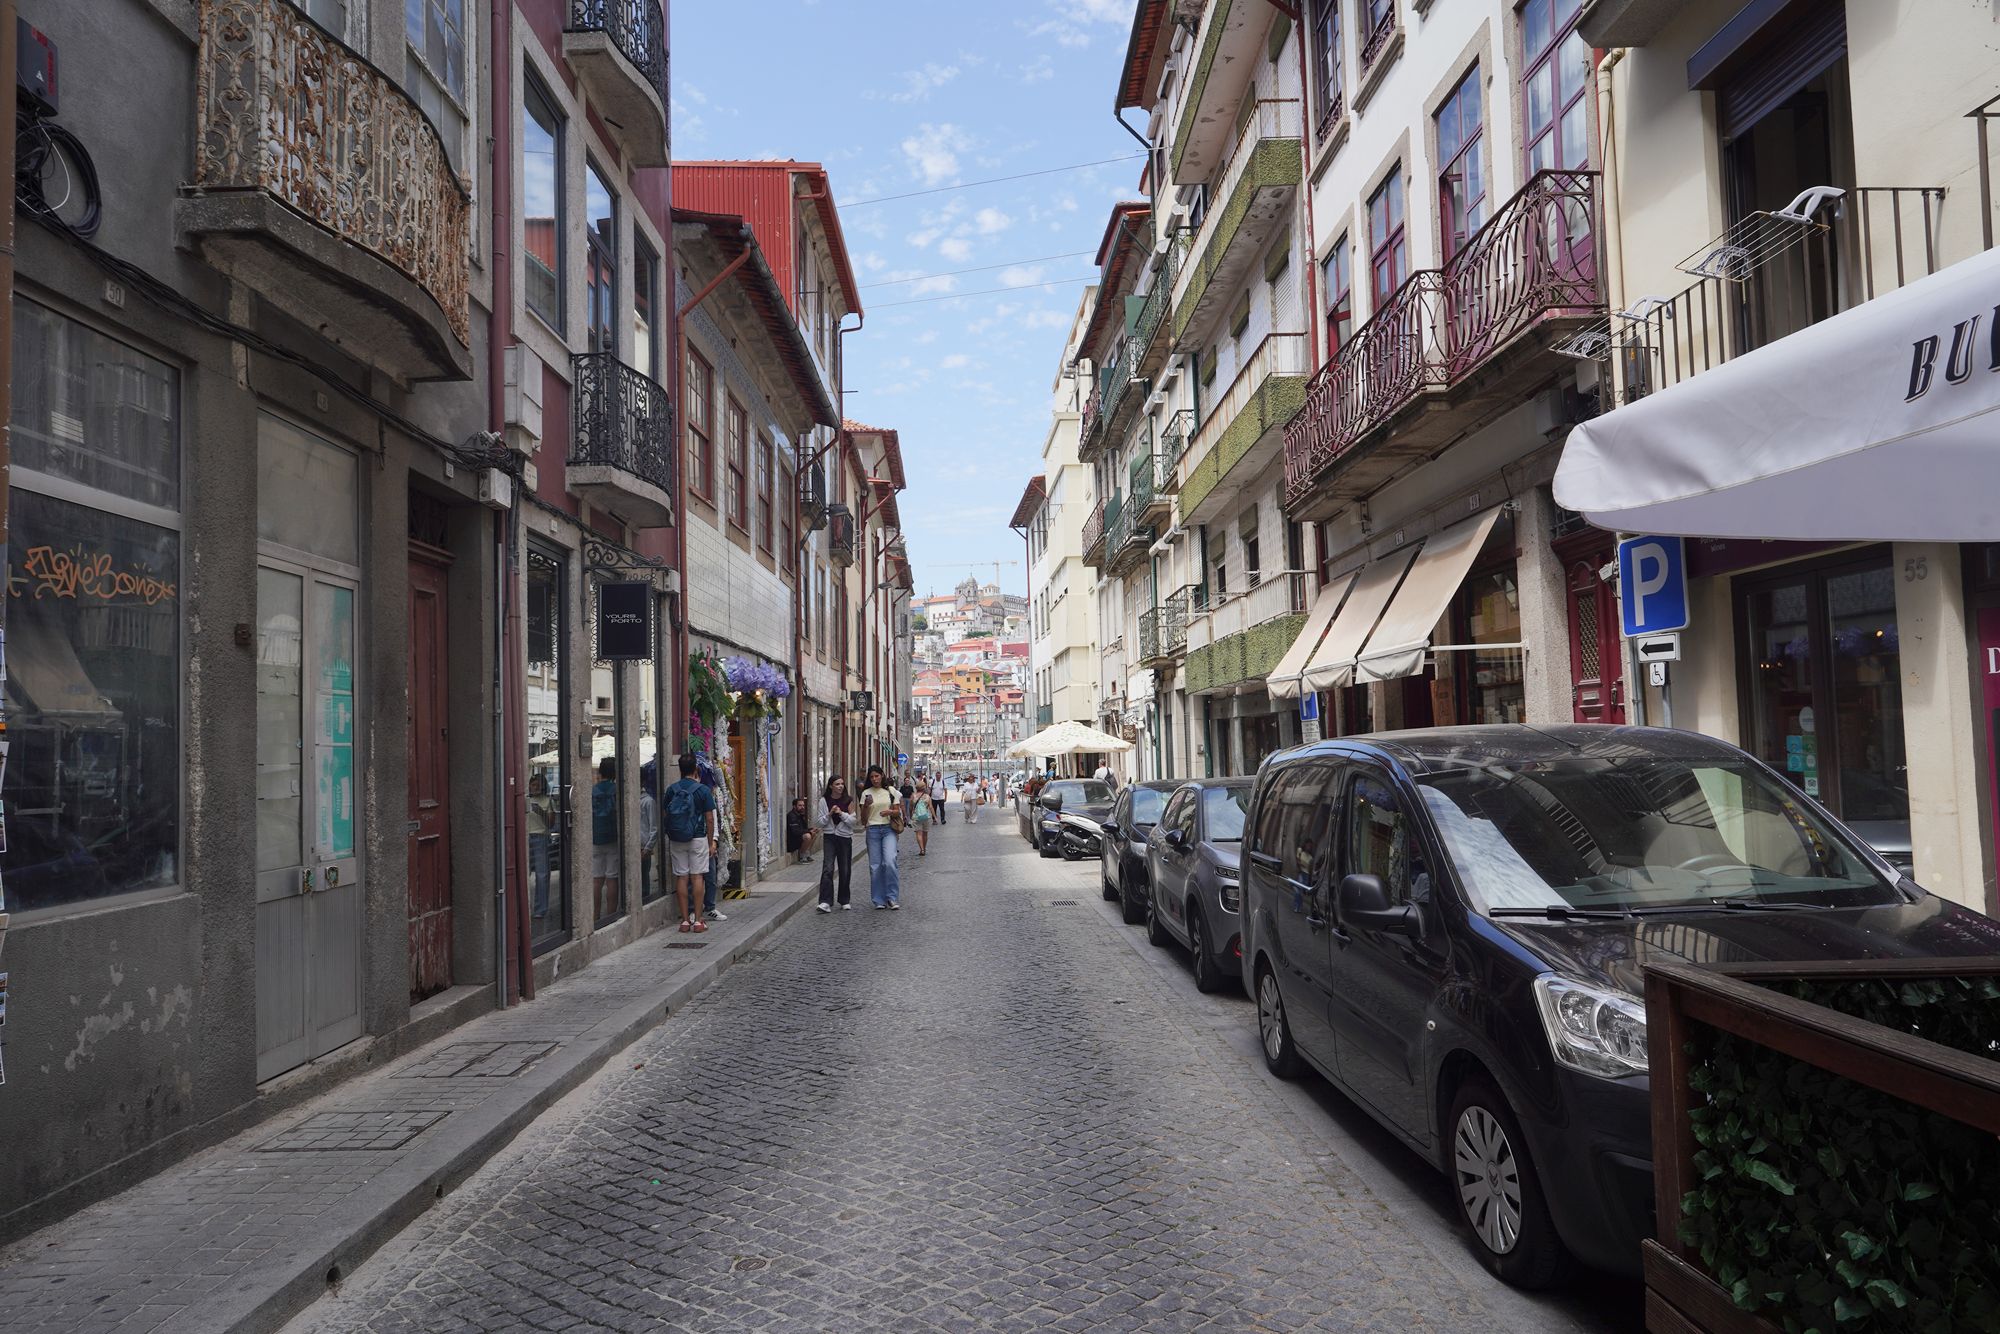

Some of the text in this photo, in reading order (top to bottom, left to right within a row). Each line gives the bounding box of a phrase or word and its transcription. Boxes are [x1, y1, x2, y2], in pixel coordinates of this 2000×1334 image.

[108, 283, 122, 304] 50
[1904, 557, 1928, 582] 55
[1631, 542, 1669, 627] P
